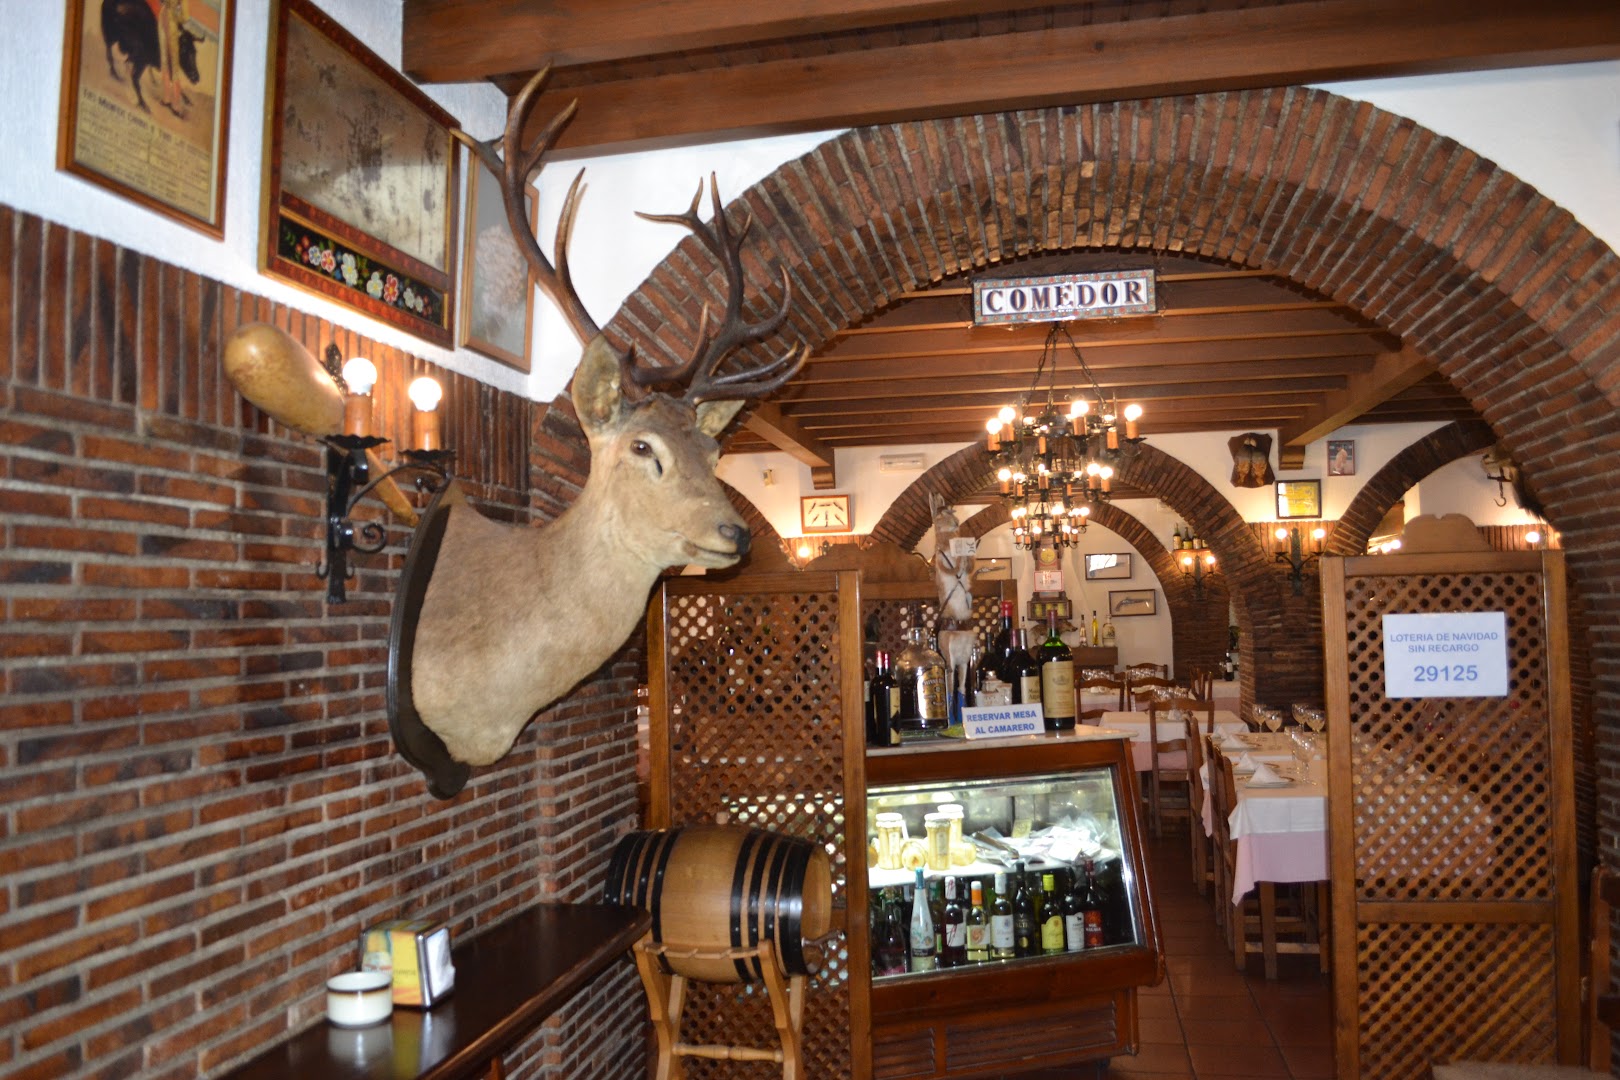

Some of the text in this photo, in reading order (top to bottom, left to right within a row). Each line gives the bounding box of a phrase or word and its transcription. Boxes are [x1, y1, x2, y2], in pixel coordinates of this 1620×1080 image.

[986, 281, 1143, 313] COMEDOR
[1390, 632, 1498, 642] LOTERIA DE NAVIDAD
[1408, 643, 1479, 653] SIN RECARGO
[1413, 665, 1478, 682] 29125
[967, 710, 1037, 722] RESERVAR MESA
[988, 723, 1035, 733] CAMARERO
